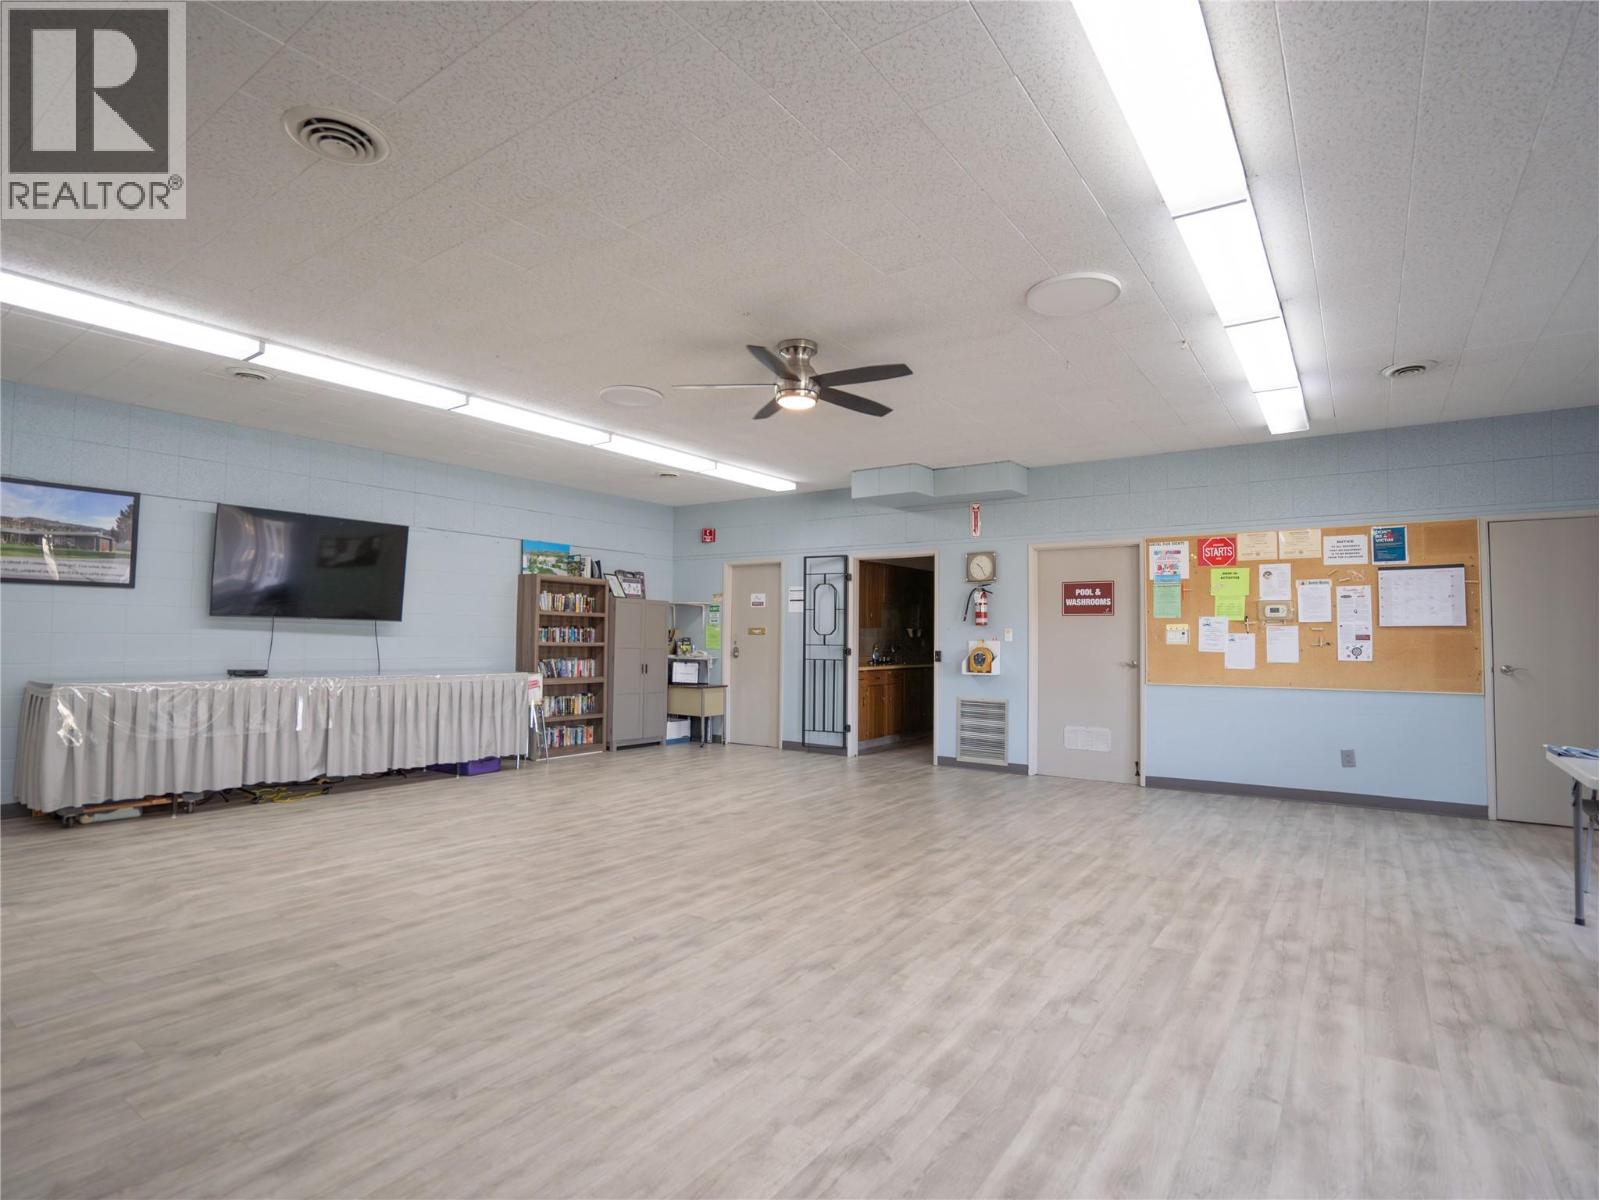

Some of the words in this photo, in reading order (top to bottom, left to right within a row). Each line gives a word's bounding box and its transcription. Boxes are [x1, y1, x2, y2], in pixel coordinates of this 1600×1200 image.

[1204, 546, 1233, 557] STARTS
[1075, 588, 1093, 596] POOL
[1094, 588, 1101, 596] &
[1065, 598, 1111, 606] WASHROOMS
